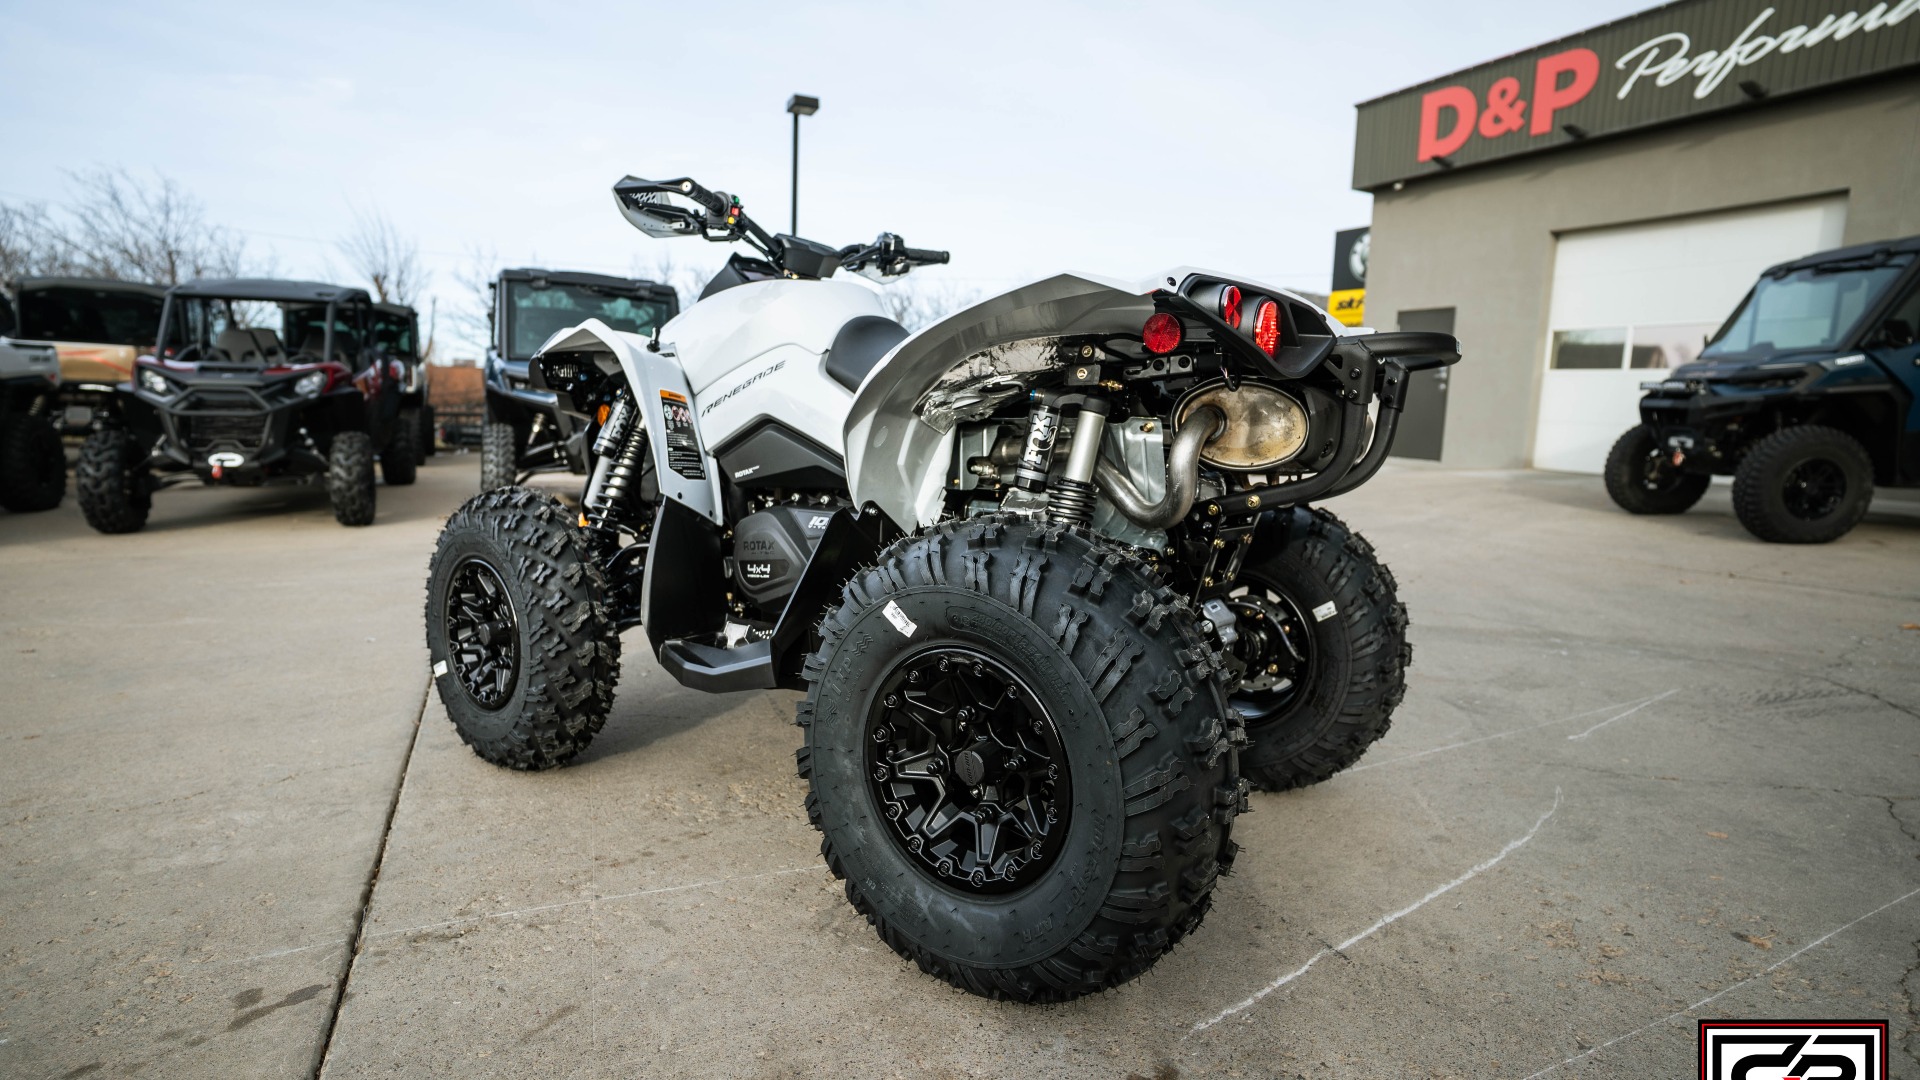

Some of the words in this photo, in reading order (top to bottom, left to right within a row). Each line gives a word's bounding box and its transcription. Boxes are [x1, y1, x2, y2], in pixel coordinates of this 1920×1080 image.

[1417, 48, 1600, 163] D&P
[701, 360, 786, 417] RENEGADE
[610, 405, 630, 440] FOX
[1023, 413, 1057, 465] FOX
[734, 467, 754, 479] ROTAX
[743, 541, 775, 551] ROTAX
[747, 564, 771, 574] 4x4
